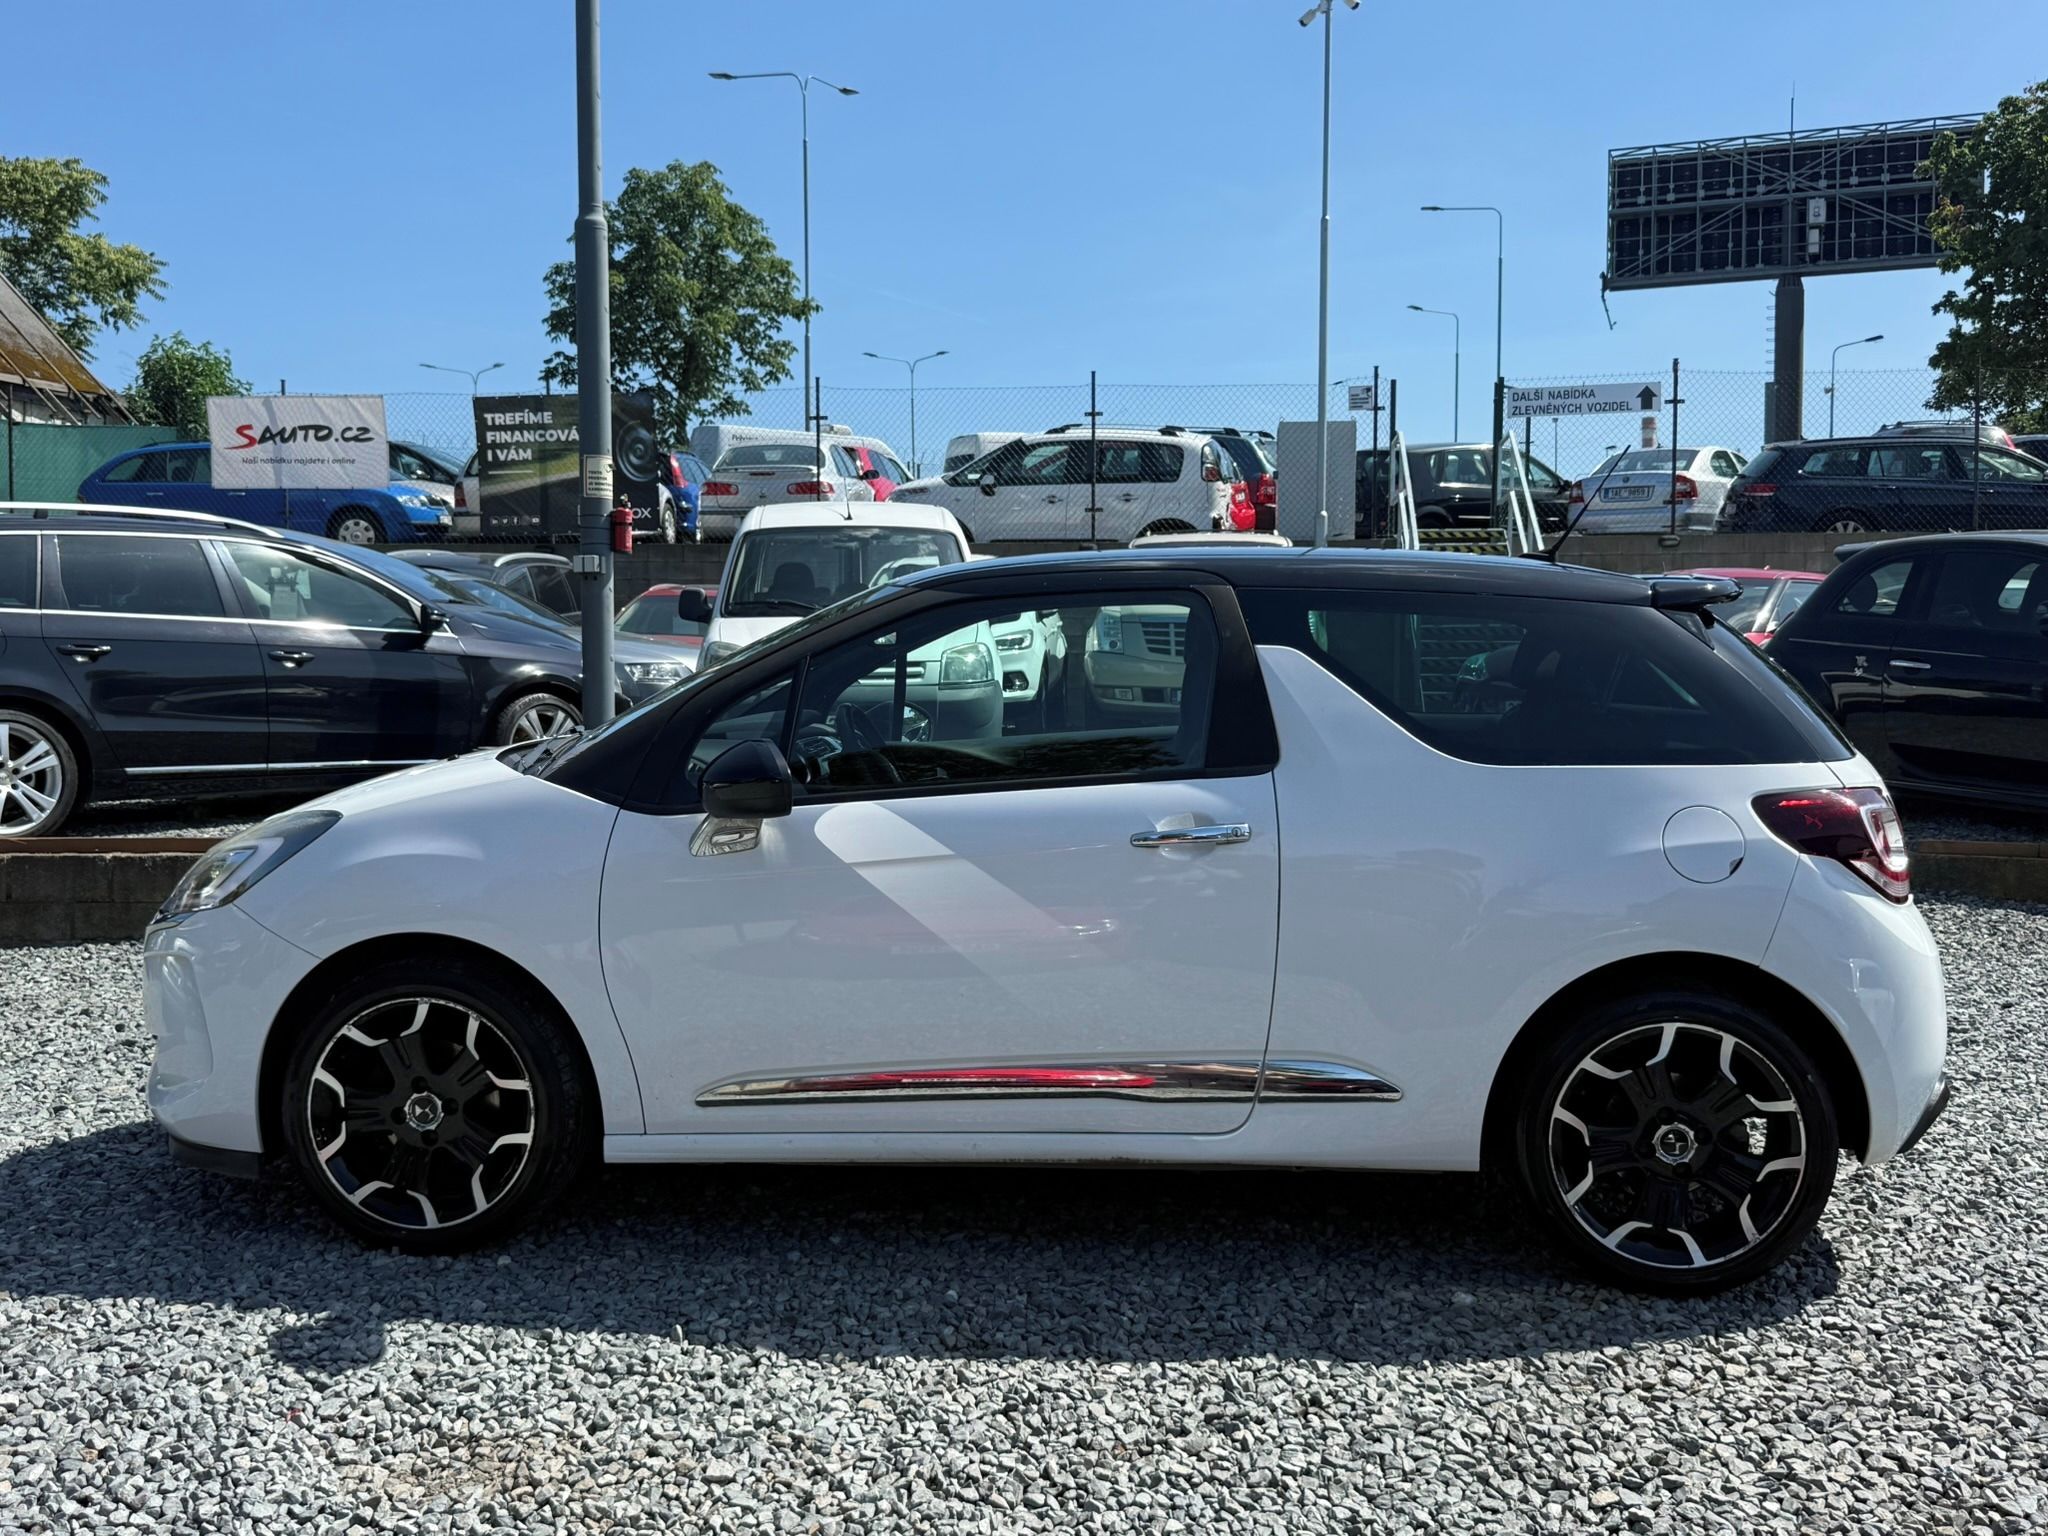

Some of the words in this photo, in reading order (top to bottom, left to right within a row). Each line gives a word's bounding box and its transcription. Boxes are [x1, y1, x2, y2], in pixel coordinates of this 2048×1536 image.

[1512, 388, 1543, 402] DALŠÍ
[1548, 387, 1596, 401] NABÍDKA
[1512, 401, 1582, 416] ZLEVNĚNÝCH
[1587, 400, 1633, 413] VOZIDEL
[484, 409, 553, 426] TREFÍME
[486, 425, 580, 444] FINANCOVÁ
[294, 457, 326, 466] najdete
[331, 456, 356, 465] online
[487, 450, 493, 462] I
[495, 446, 533, 462] VÁM
